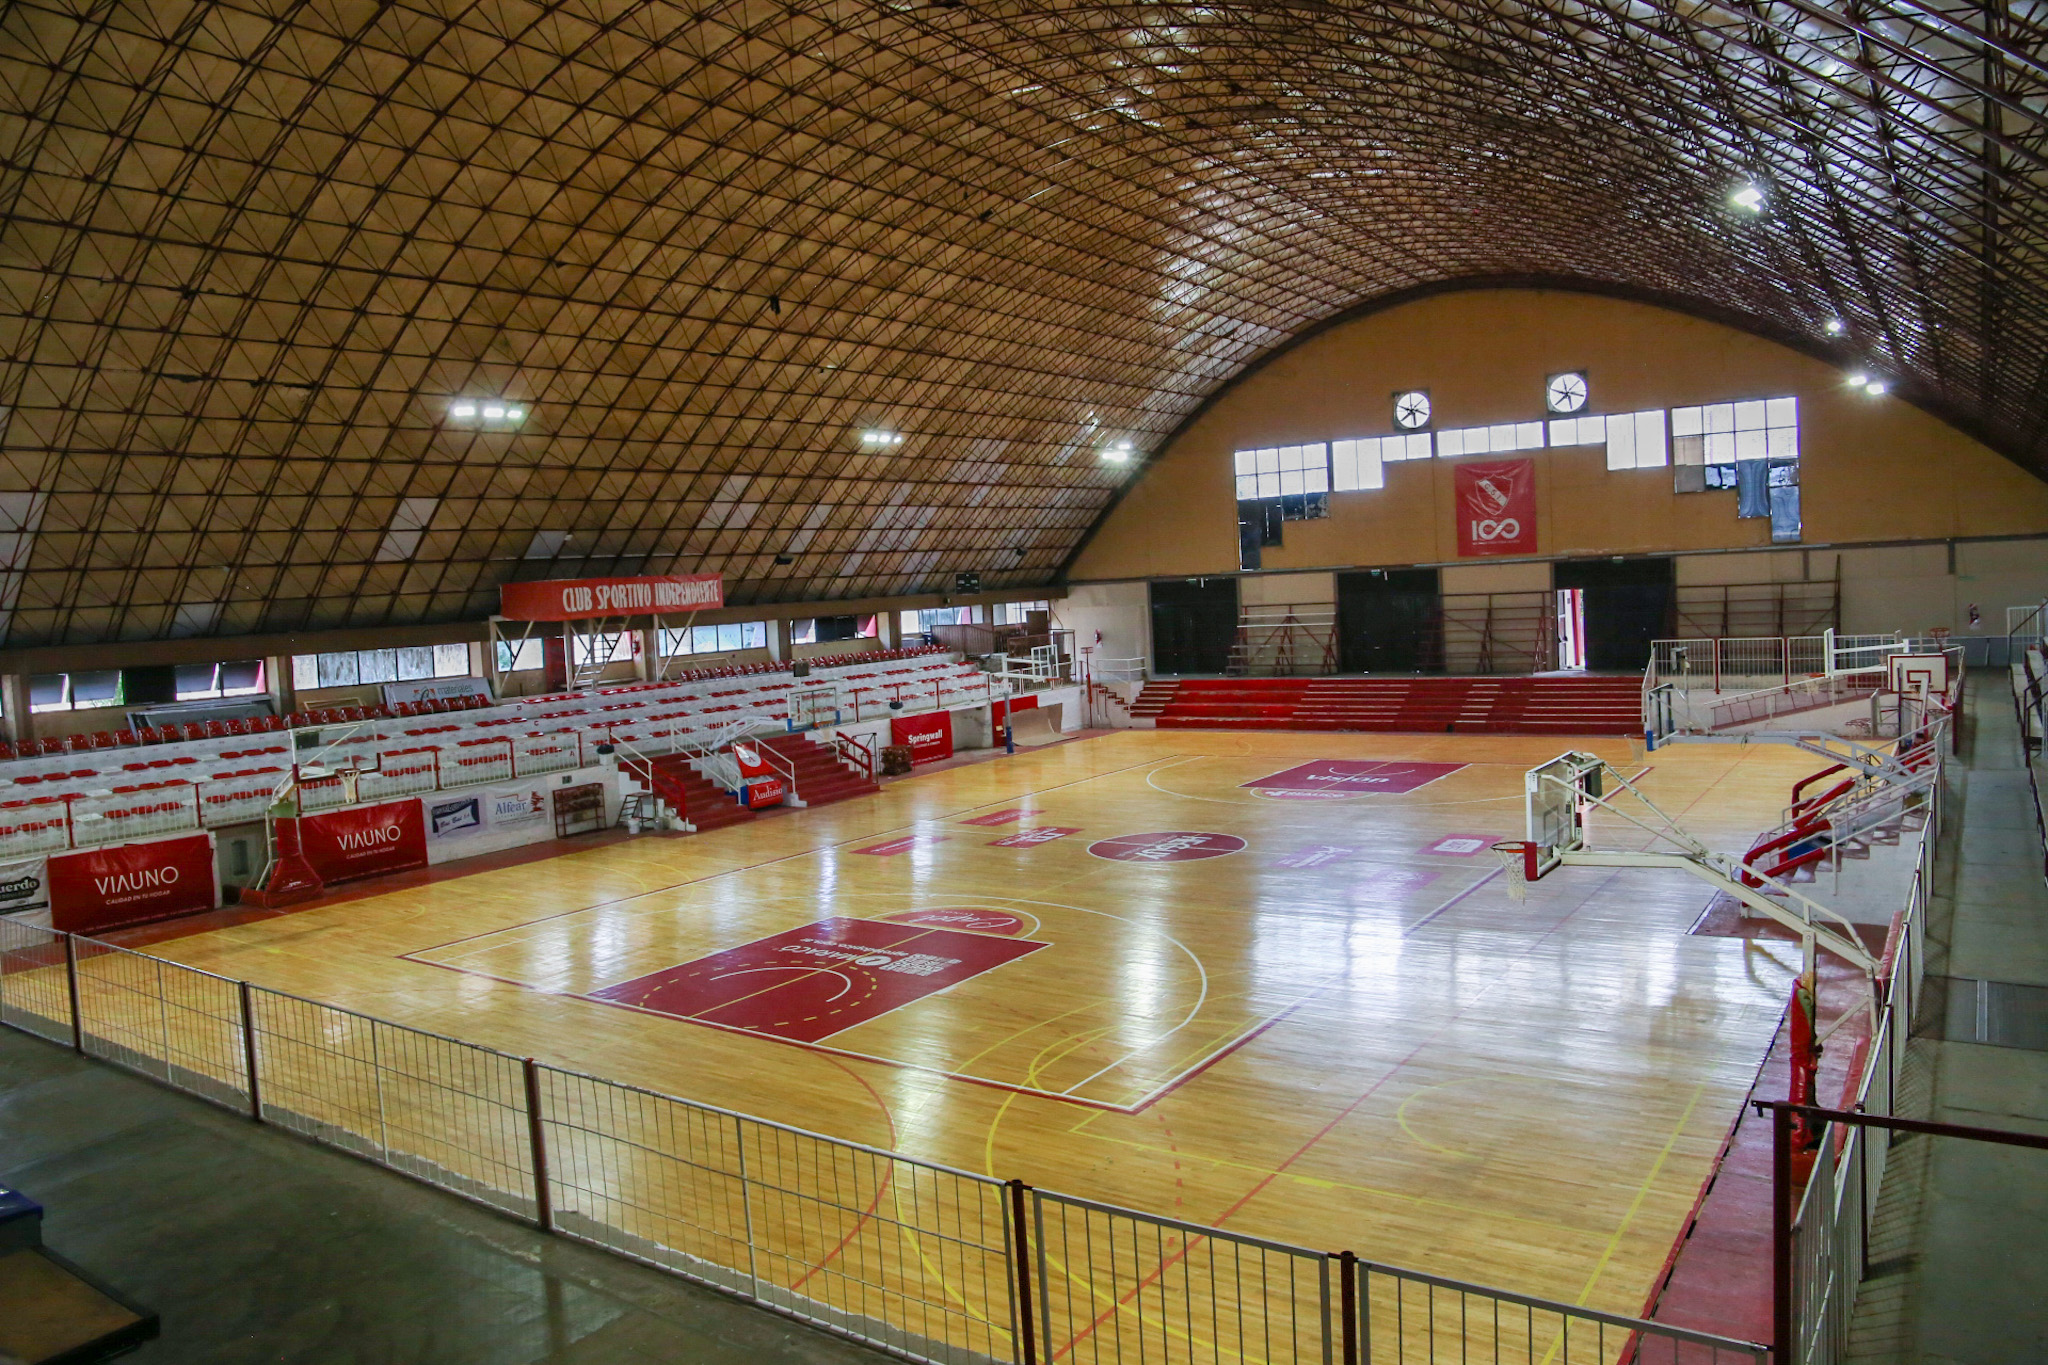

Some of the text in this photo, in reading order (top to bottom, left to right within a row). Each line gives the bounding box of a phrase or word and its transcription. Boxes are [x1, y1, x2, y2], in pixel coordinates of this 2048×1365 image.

[562, 579, 719, 612] CLUB SPORTIVO INDEPENDIENTE
[908, 728, 943, 745] Springwall
[753, 785, 783, 801] Audisio
[495, 801, 527, 816] Alfear
[336, 825, 401, 851] VIAUNO
[94, 866, 179, 895] VIAUNO
[105, 896, 132, 905] CALIDAD
